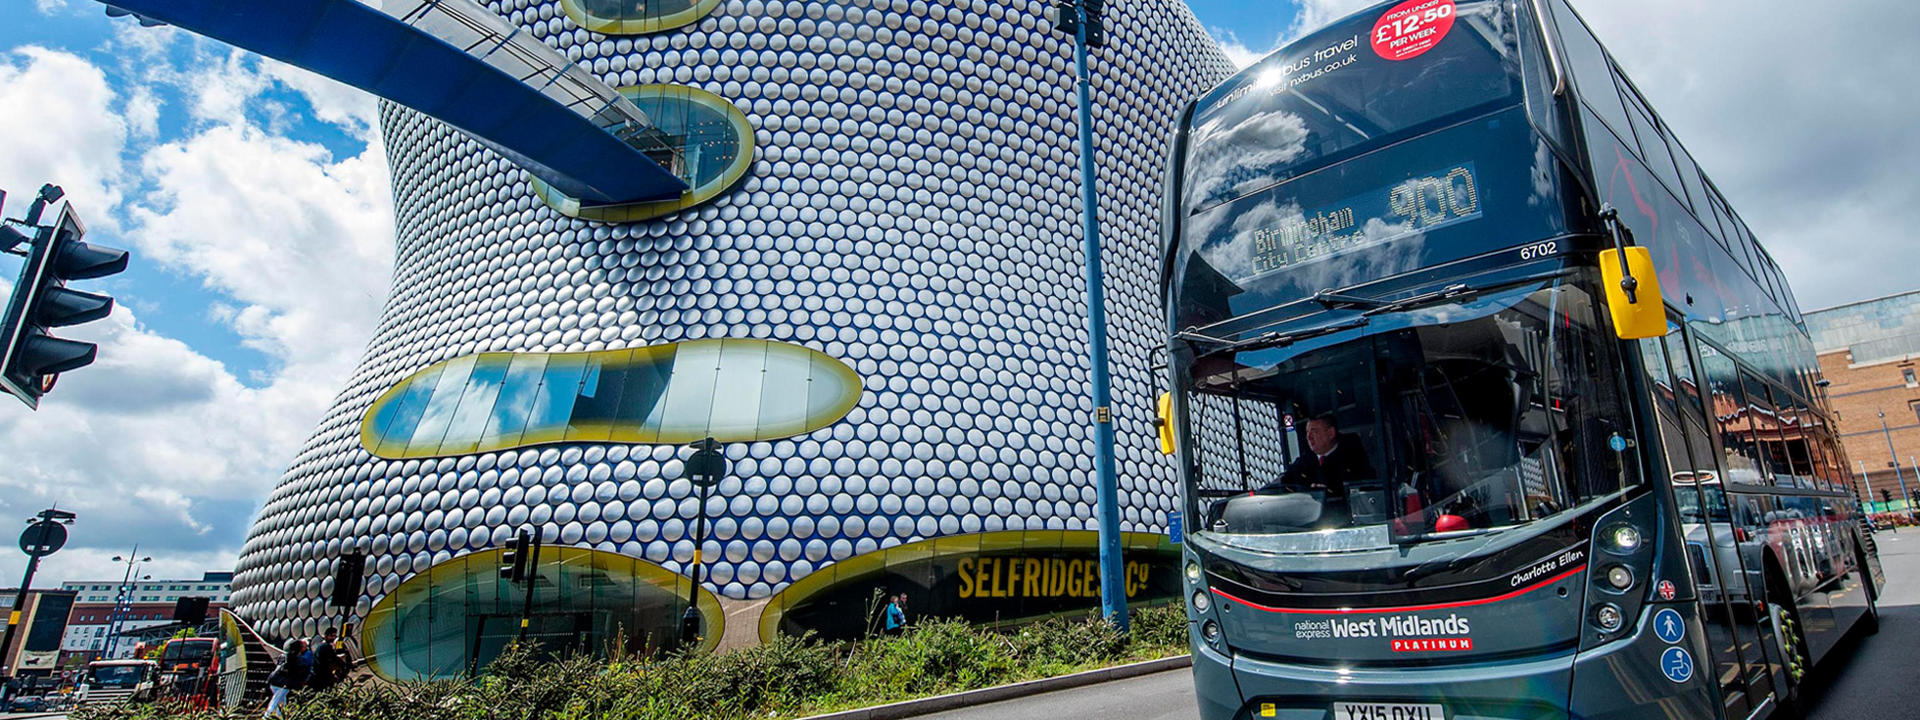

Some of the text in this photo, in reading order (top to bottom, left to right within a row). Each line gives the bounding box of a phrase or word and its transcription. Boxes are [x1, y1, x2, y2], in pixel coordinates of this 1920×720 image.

[1387, 0, 1439, 20] FROM UNDER
[1376, 4, 1451, 44] £12.50
[1390, 36, 1408, 49] PER
[1409, 26, 1437, 41] WEEK
[1314, 34, 1358, 63] travel
[1289, 53, 1357, 87] nxbus.co.uk
[1390, 166, 1477, 233] 900
[1254, 206, 1355, 254] Birmingham
[1251, 230, 1365, 276] City Centre
[1520, 241, 1558, 260] 6702
[1511, 550, 1584, 587] Charlotte Ellen
[1295, 619, 1330, 631] national
[1295, 629, 1331, 641] express
[1331, 613, 1470, 638] West Midlands
[1394, 640, 1470, 650] PLATINUM
